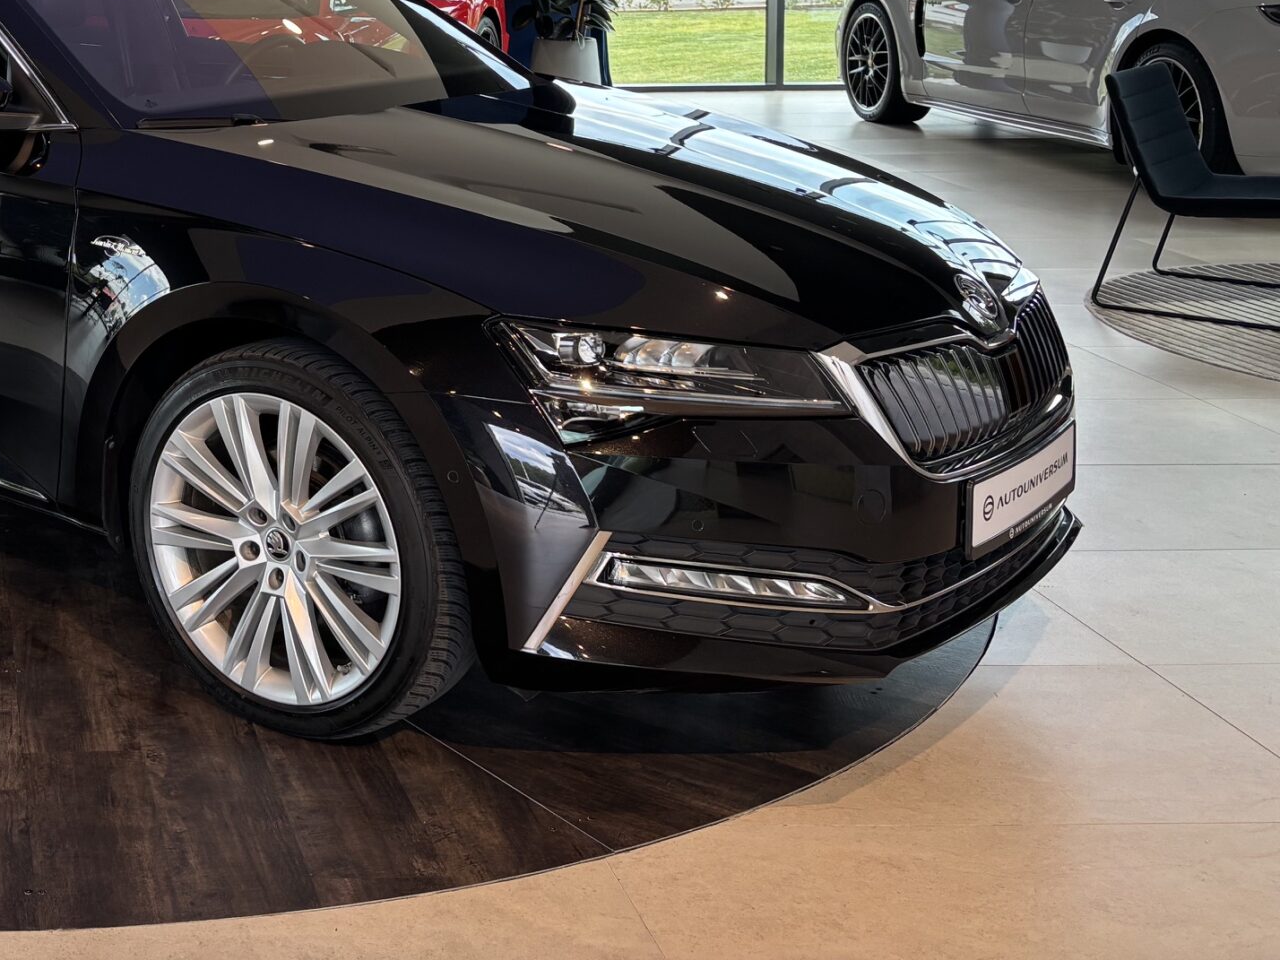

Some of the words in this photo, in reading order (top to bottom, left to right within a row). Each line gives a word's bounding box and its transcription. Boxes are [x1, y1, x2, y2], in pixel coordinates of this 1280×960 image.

[236, 367, 331, 405] MICHELIN
[336, 406, 358, 425] PILOT
[997, 451, 1069, 510] AUTOUNIVERSUM
